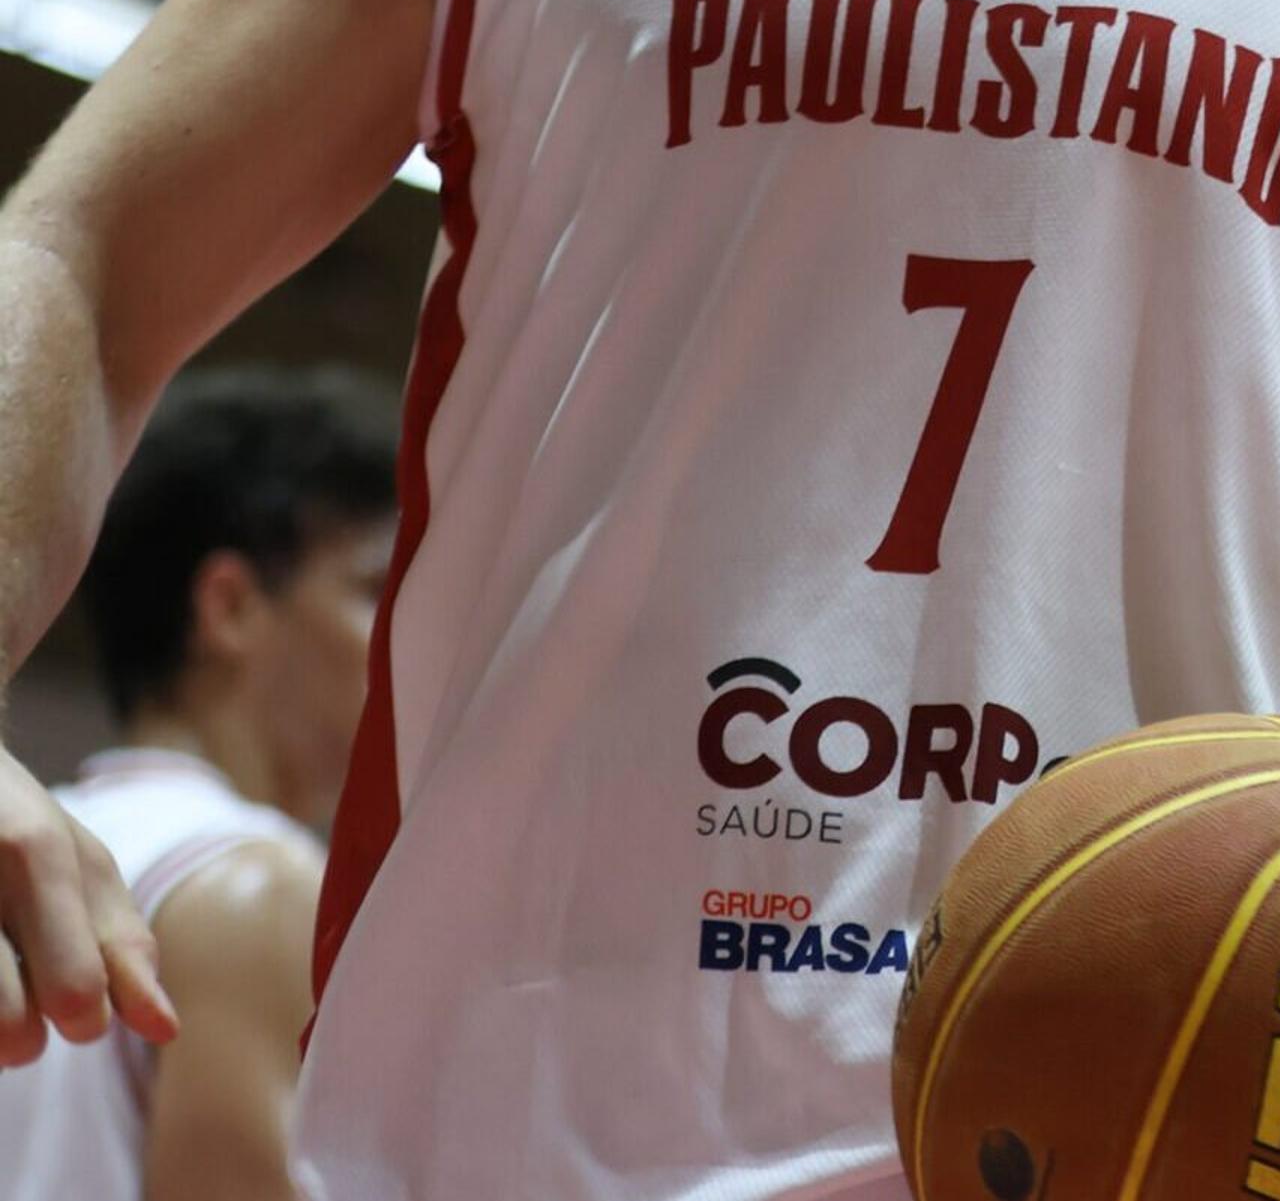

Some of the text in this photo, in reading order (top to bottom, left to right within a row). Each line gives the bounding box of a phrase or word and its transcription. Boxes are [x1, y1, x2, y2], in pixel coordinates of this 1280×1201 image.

[864, 253, 1037, 575] 7
[696, 800, 844, 843] SAÚDE
[702, 890, 812, 921] GRUPO
